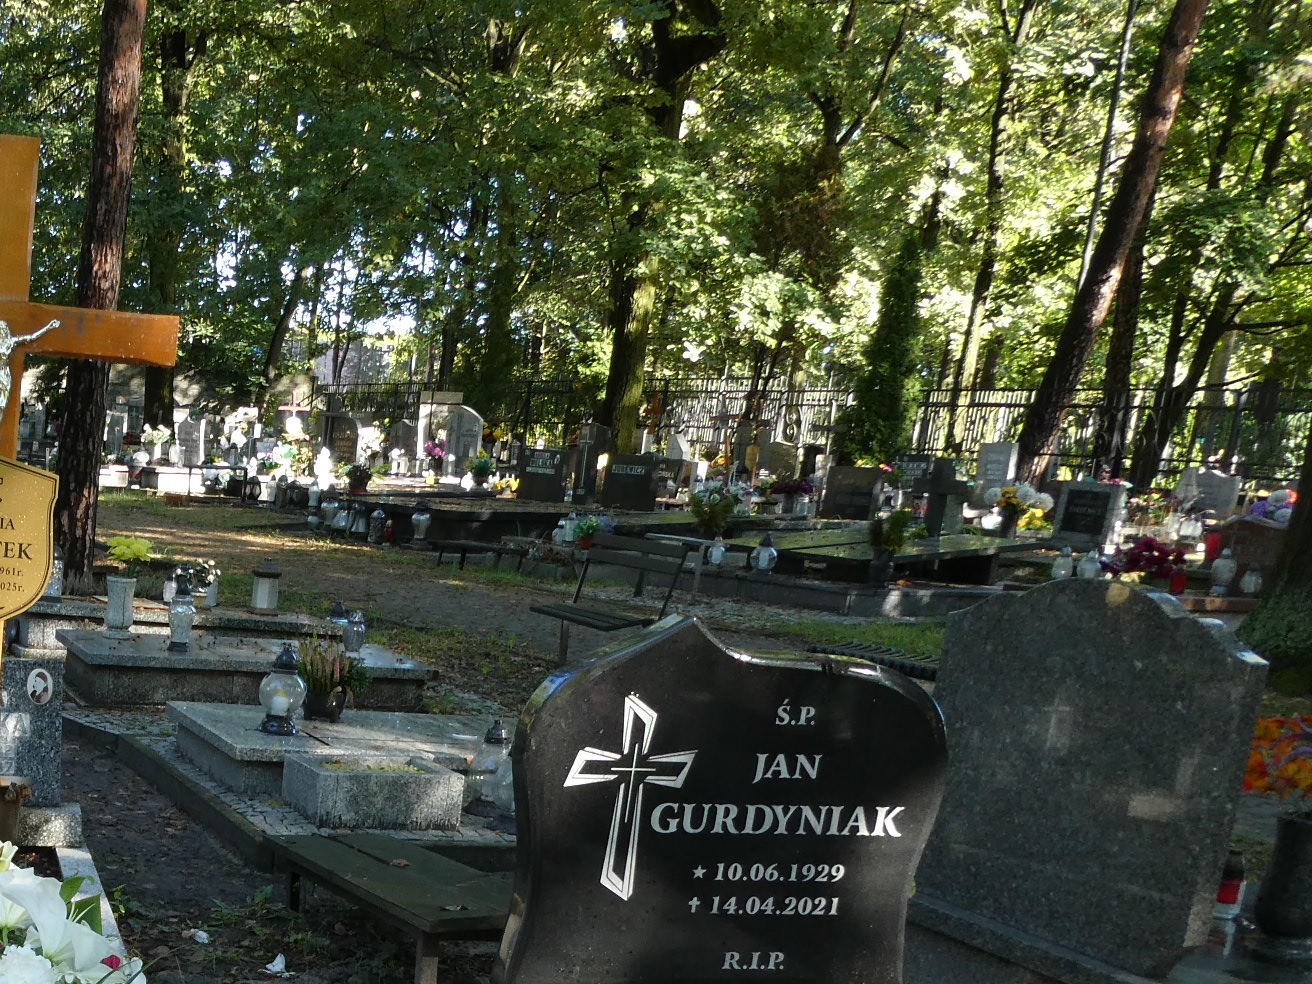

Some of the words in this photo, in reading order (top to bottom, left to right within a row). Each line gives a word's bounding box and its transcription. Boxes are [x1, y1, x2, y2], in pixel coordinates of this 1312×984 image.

[775, 698, 816, 727] Ś.P.
[751, 752, 823, 784] JAN
[650, 802, 905, 840] GURDYNIAK
[714, 862, 845, 884] 10.06.1929
[710, 896, 840, 917] 14.04.2021
[721, 950, 786, 971] R.I.P.
